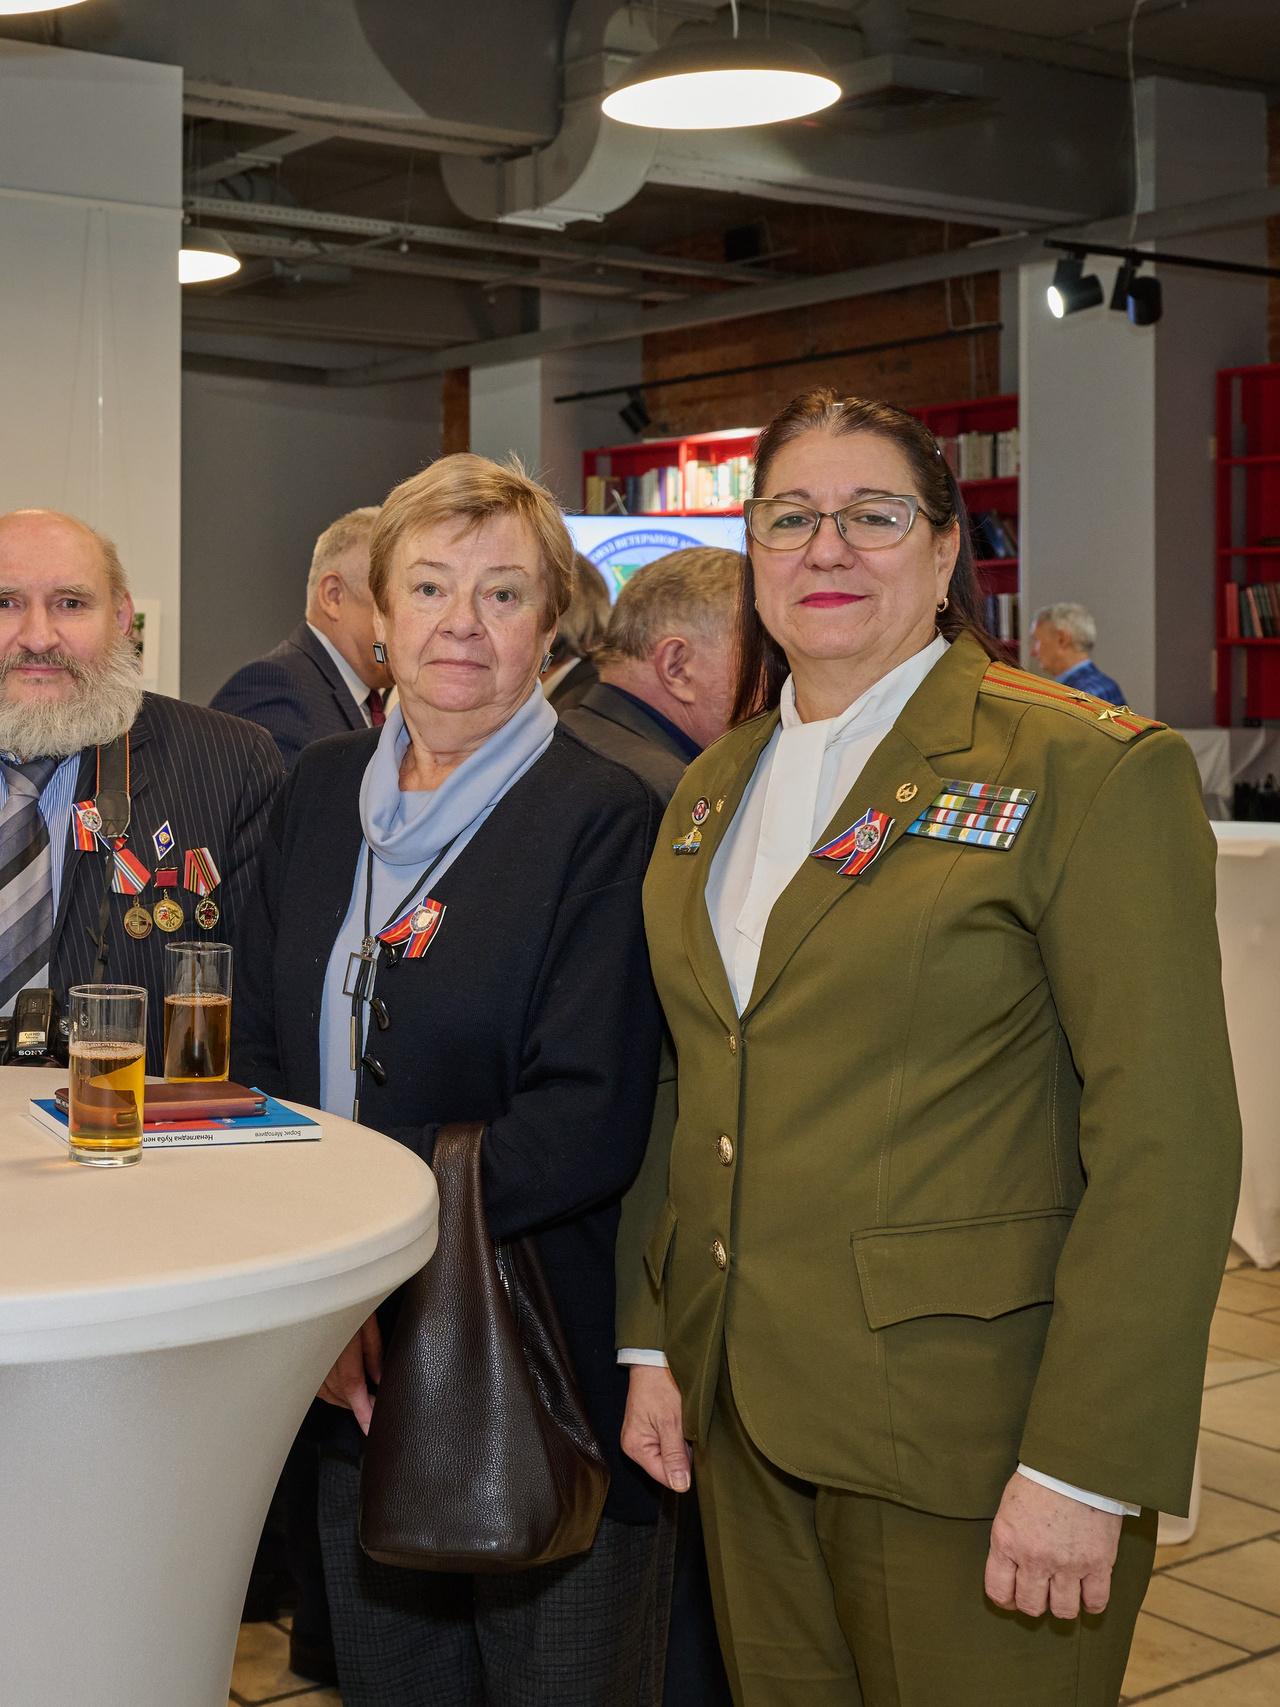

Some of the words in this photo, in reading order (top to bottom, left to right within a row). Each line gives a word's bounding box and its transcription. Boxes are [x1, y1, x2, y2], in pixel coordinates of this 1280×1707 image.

[590, 543, 615, 562] ОЮЗ
[615, 533, 678, 549] ВЕТЕРАНОВ
[156, 1135, 173, 1143] Куба
[174, 1134, 214, 1142] Ненагледна
